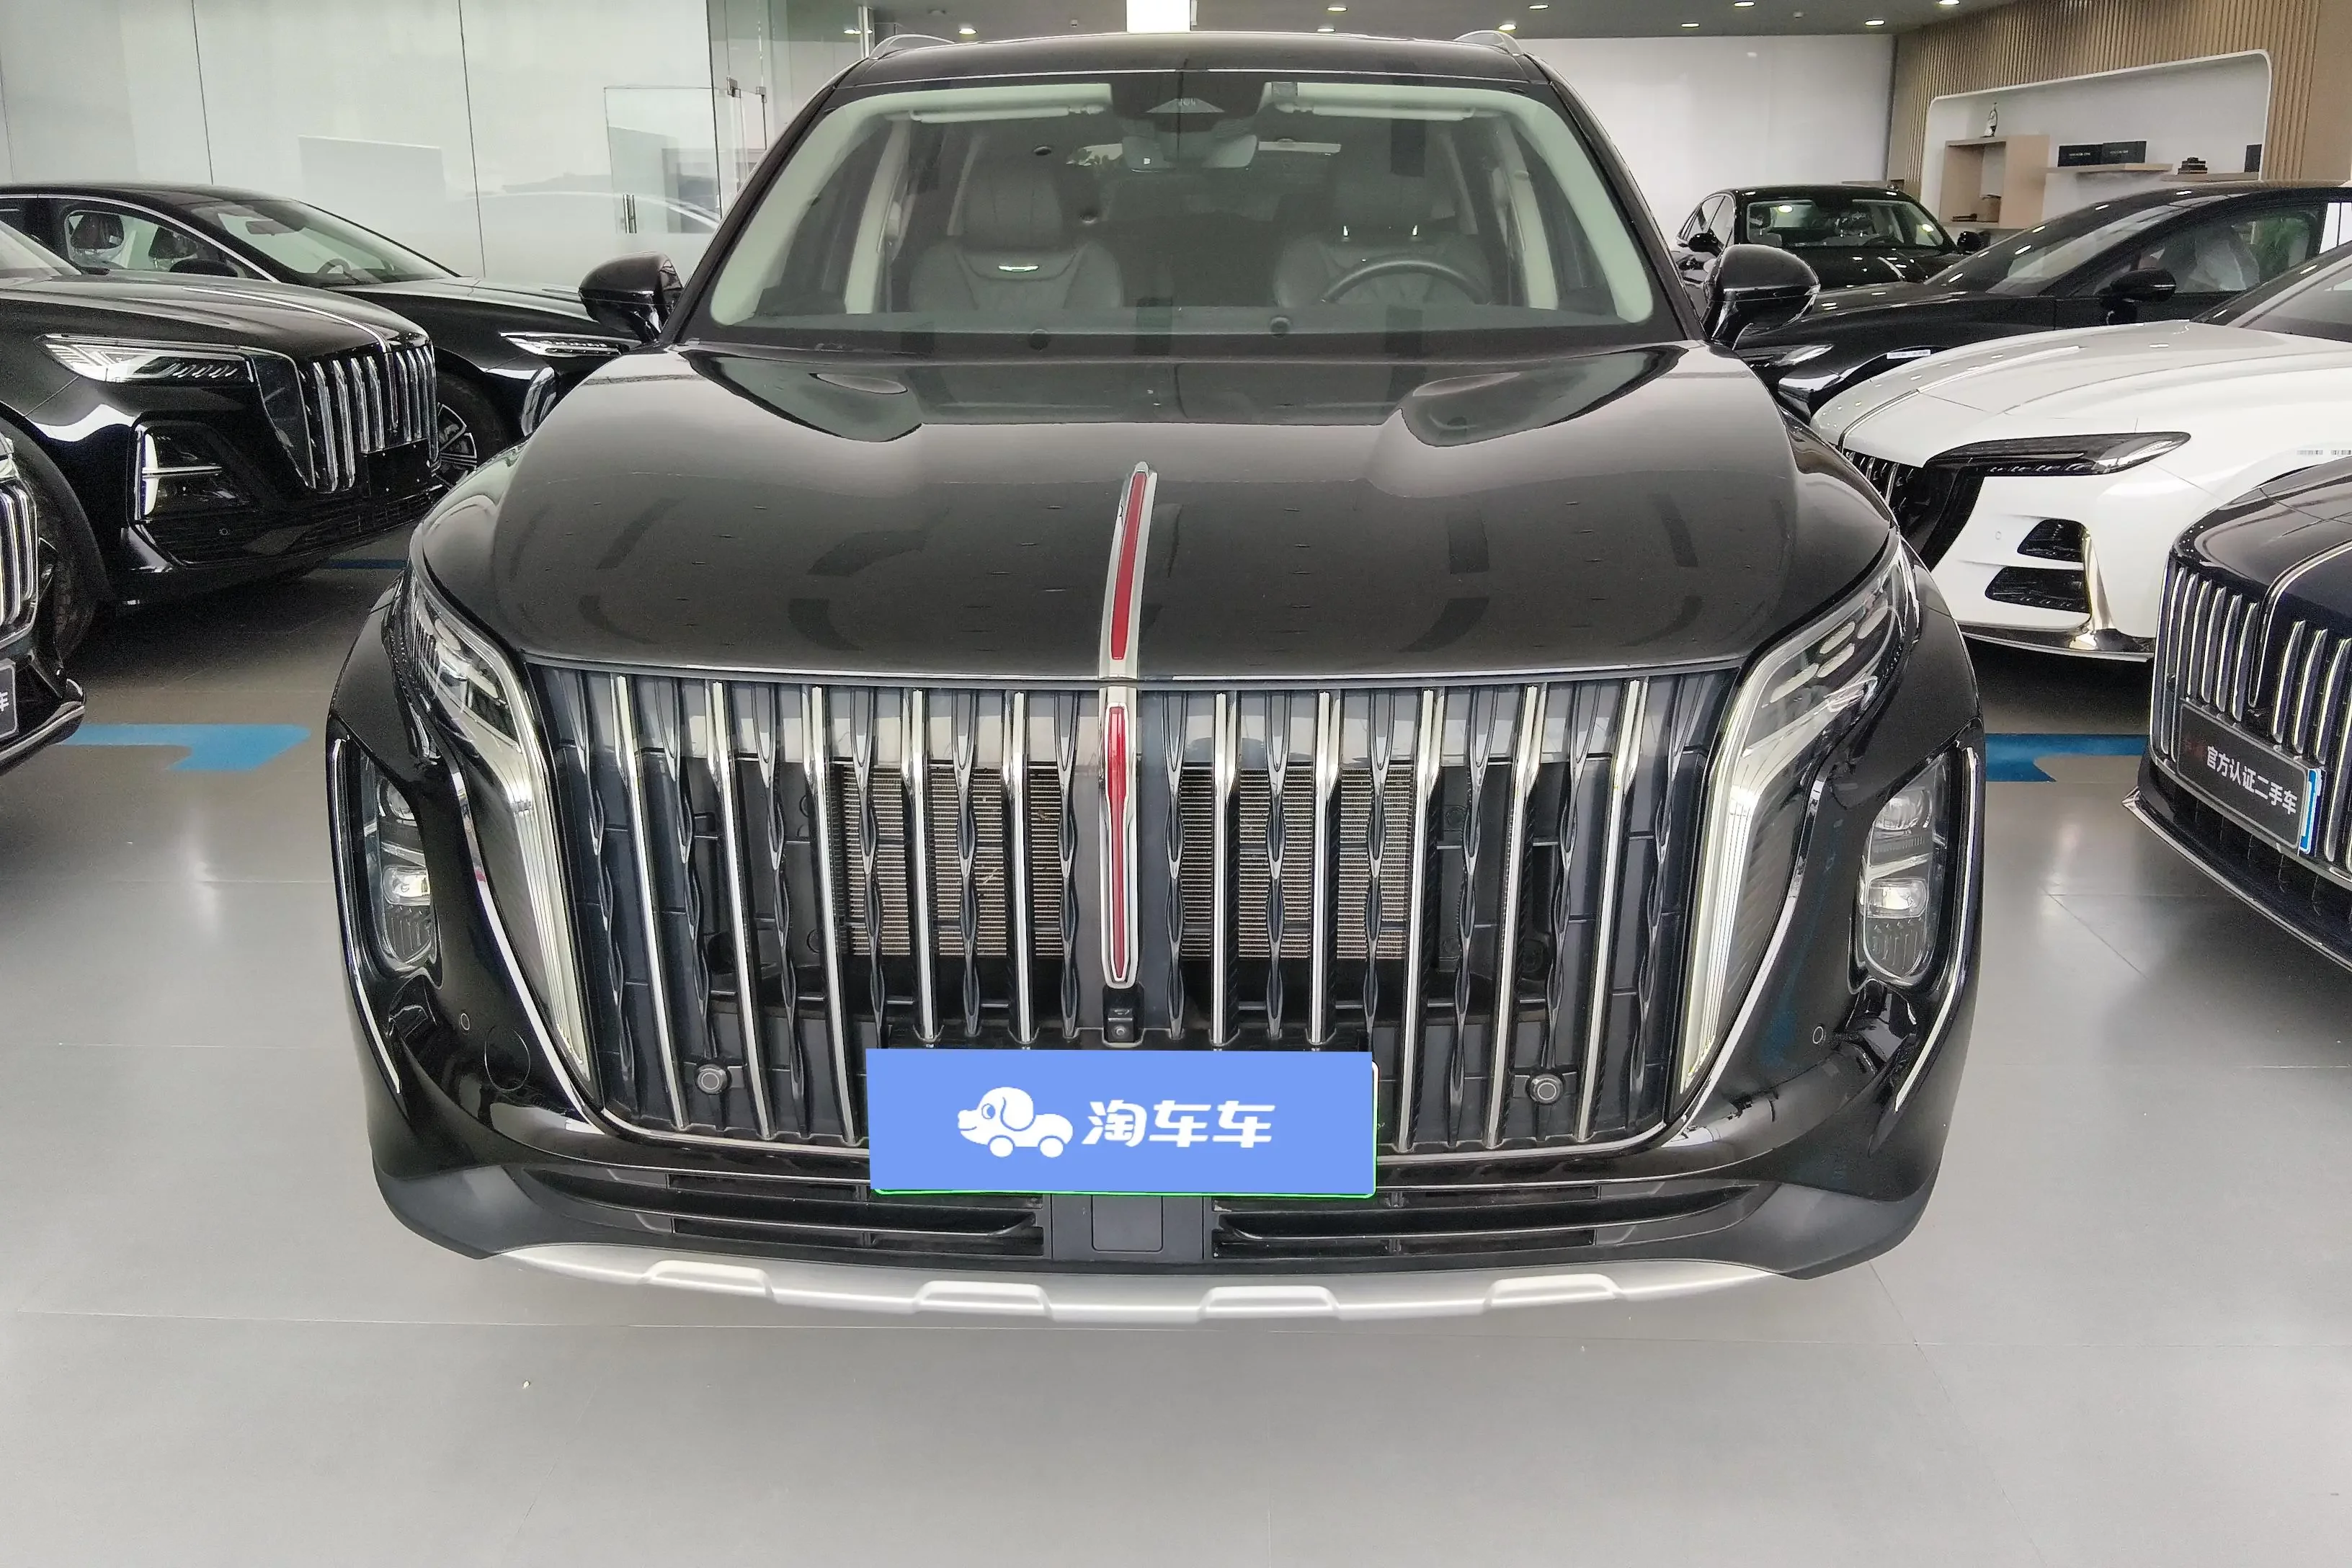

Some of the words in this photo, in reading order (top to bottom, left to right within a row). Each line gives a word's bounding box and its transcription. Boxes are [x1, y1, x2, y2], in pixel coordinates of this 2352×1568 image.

[2206, 745, 2299, 816] 官方认证二手车
